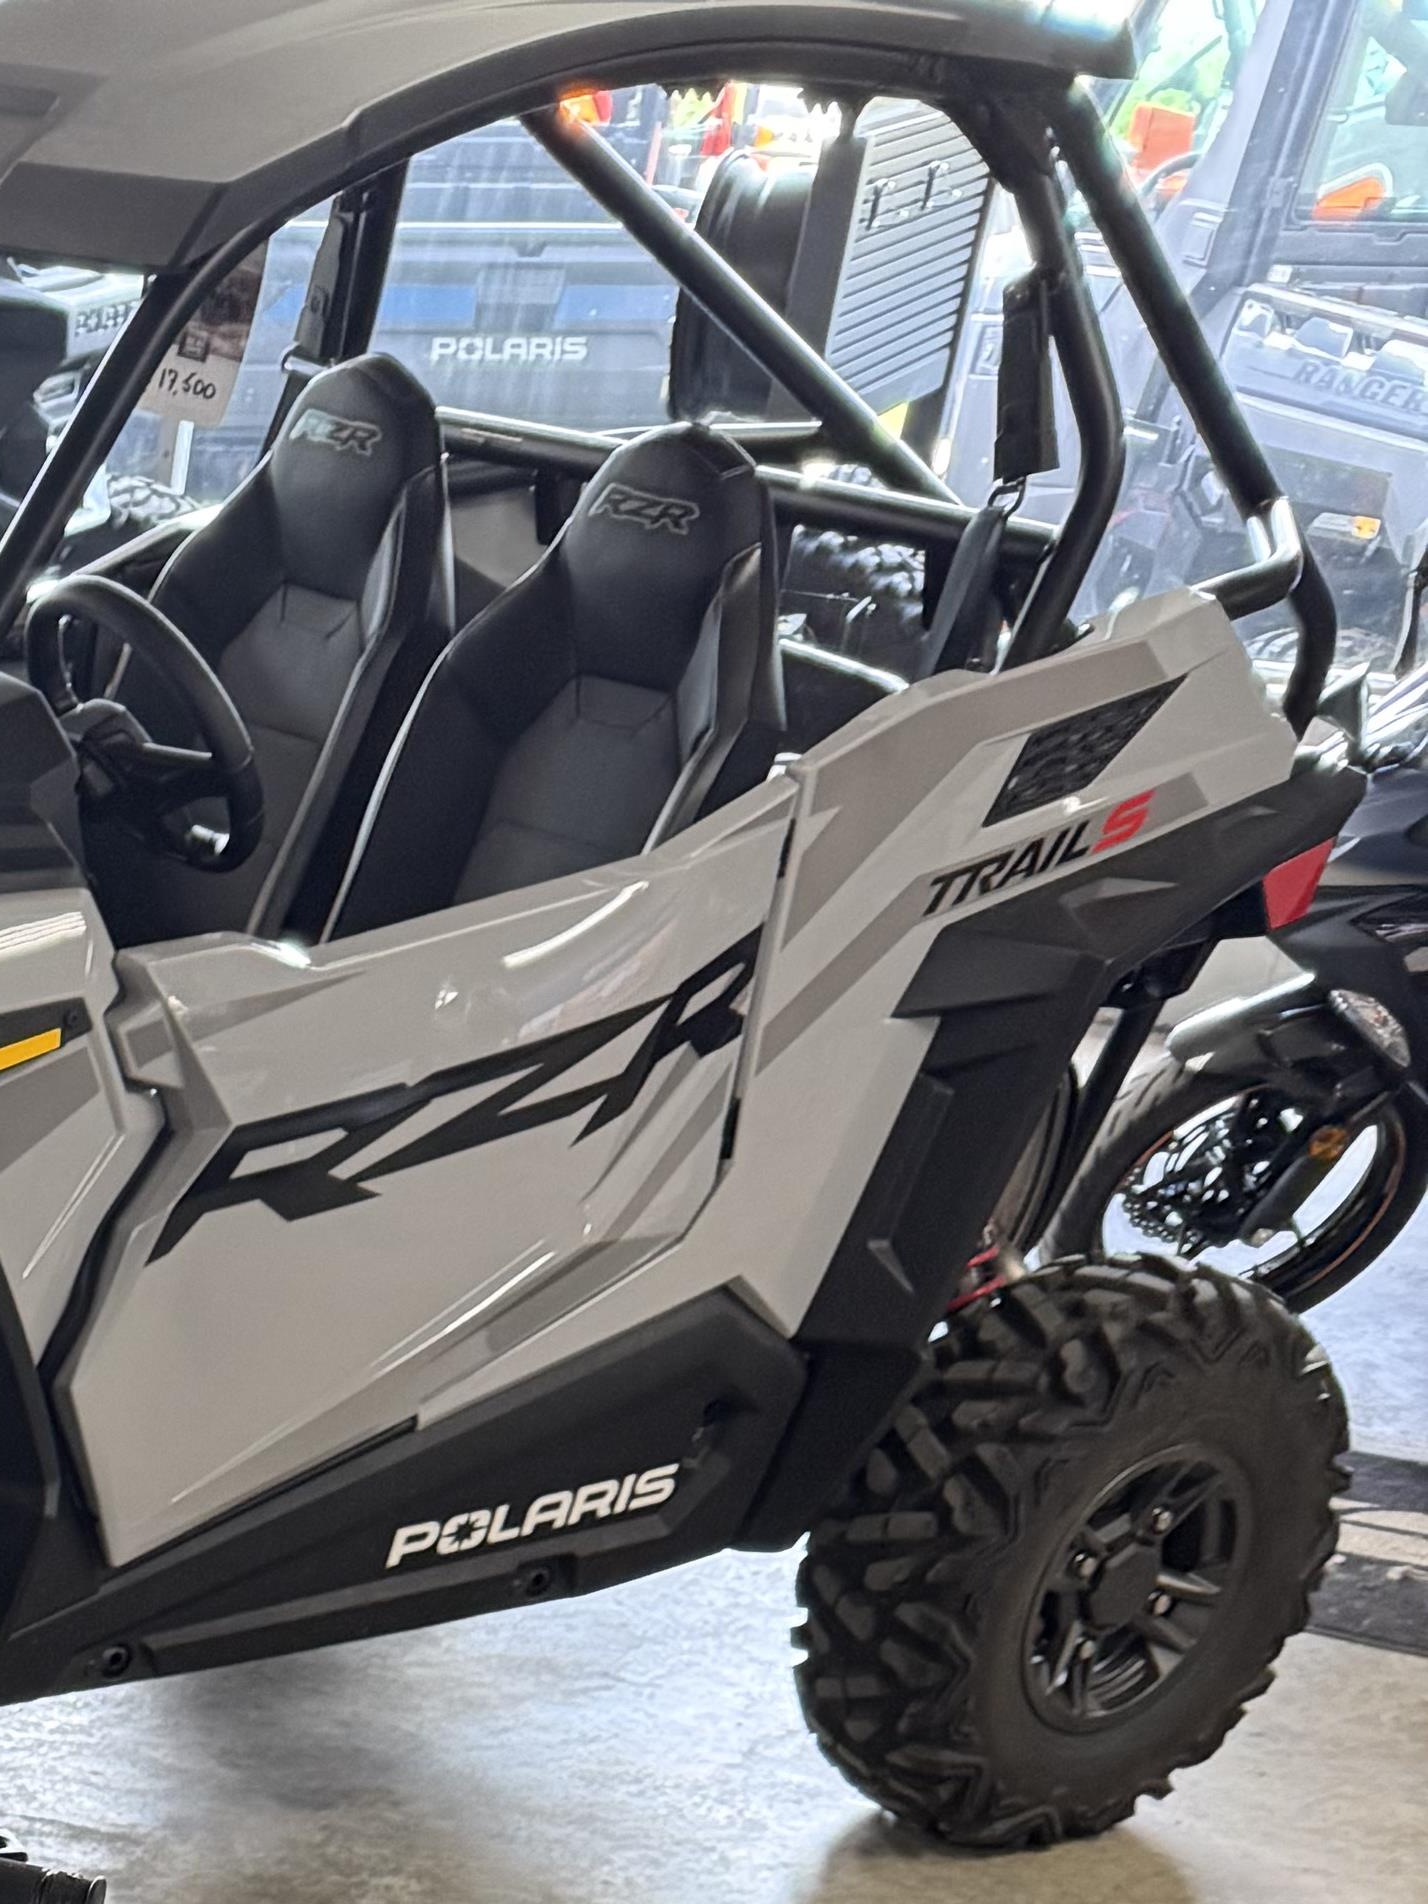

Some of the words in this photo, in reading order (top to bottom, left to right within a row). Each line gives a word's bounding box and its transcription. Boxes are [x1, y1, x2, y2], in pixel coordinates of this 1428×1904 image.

[430, 337, 587, 361] POLARIS
[289, 409, 382, 456] RZR
[589, 483, 700, 535] RZR
[922, 819, 1091, 917] TRAIL
[385, 1462, 680, 1569] POLARIS
